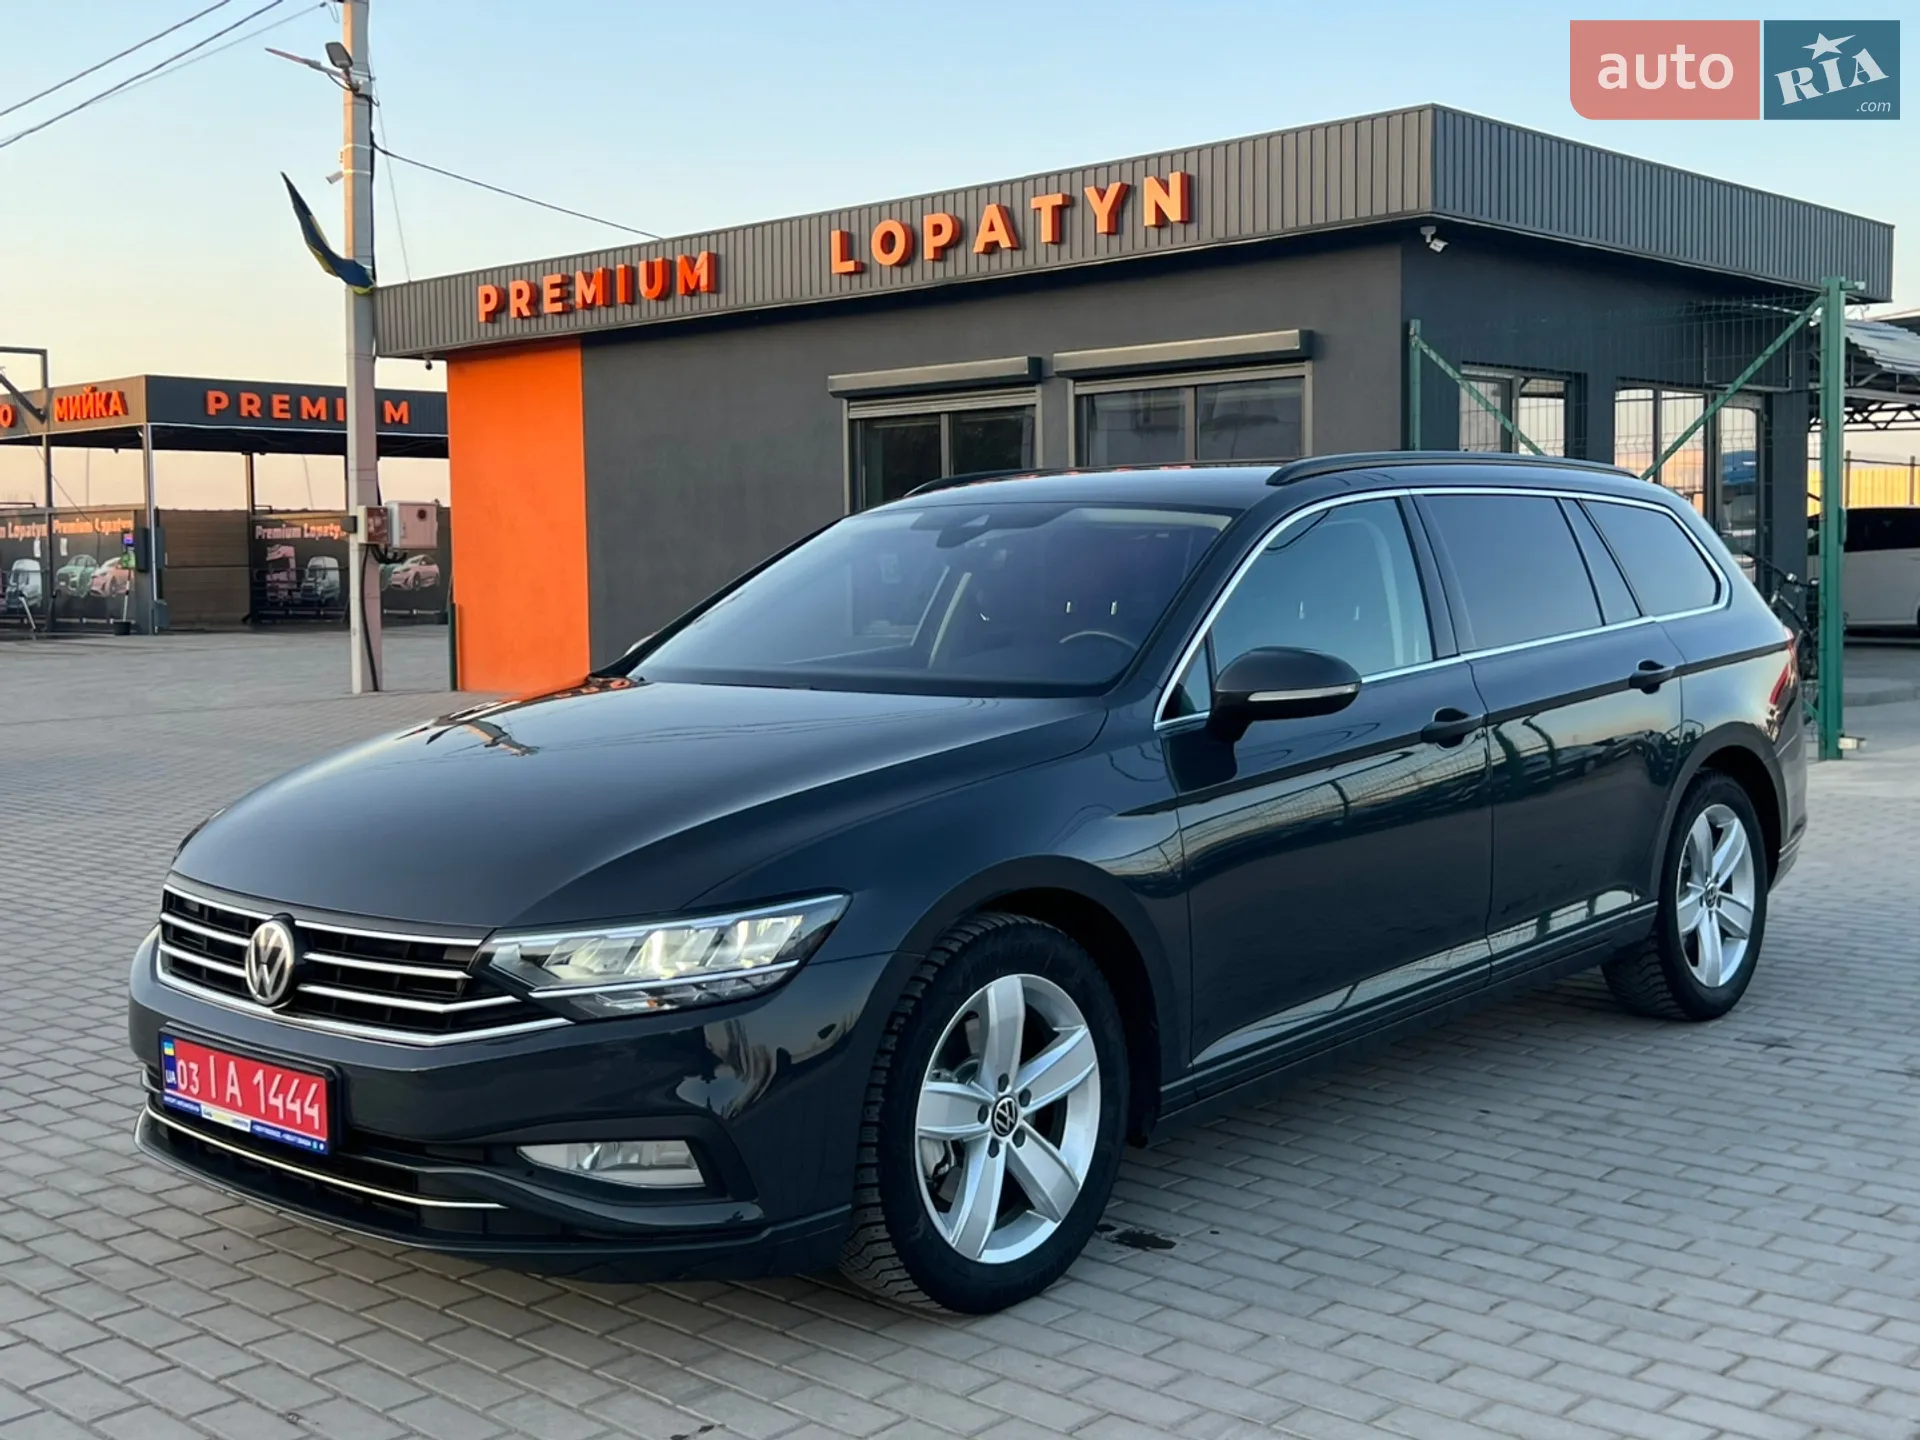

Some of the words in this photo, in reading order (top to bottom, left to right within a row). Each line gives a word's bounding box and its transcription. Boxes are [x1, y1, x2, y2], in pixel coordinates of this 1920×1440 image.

[477, 250, 718, 324] PREMIUM
[830, 170, 1191, 276] LOPATYN
[54, 386, 128, 422] МИЙКА
[205, 390, 411, 425] PREMIM
[255, 524, 302, 539] Premium
[177, 1059, 200, 1096] 03
[253, 1069, 320, 1130] 1444
